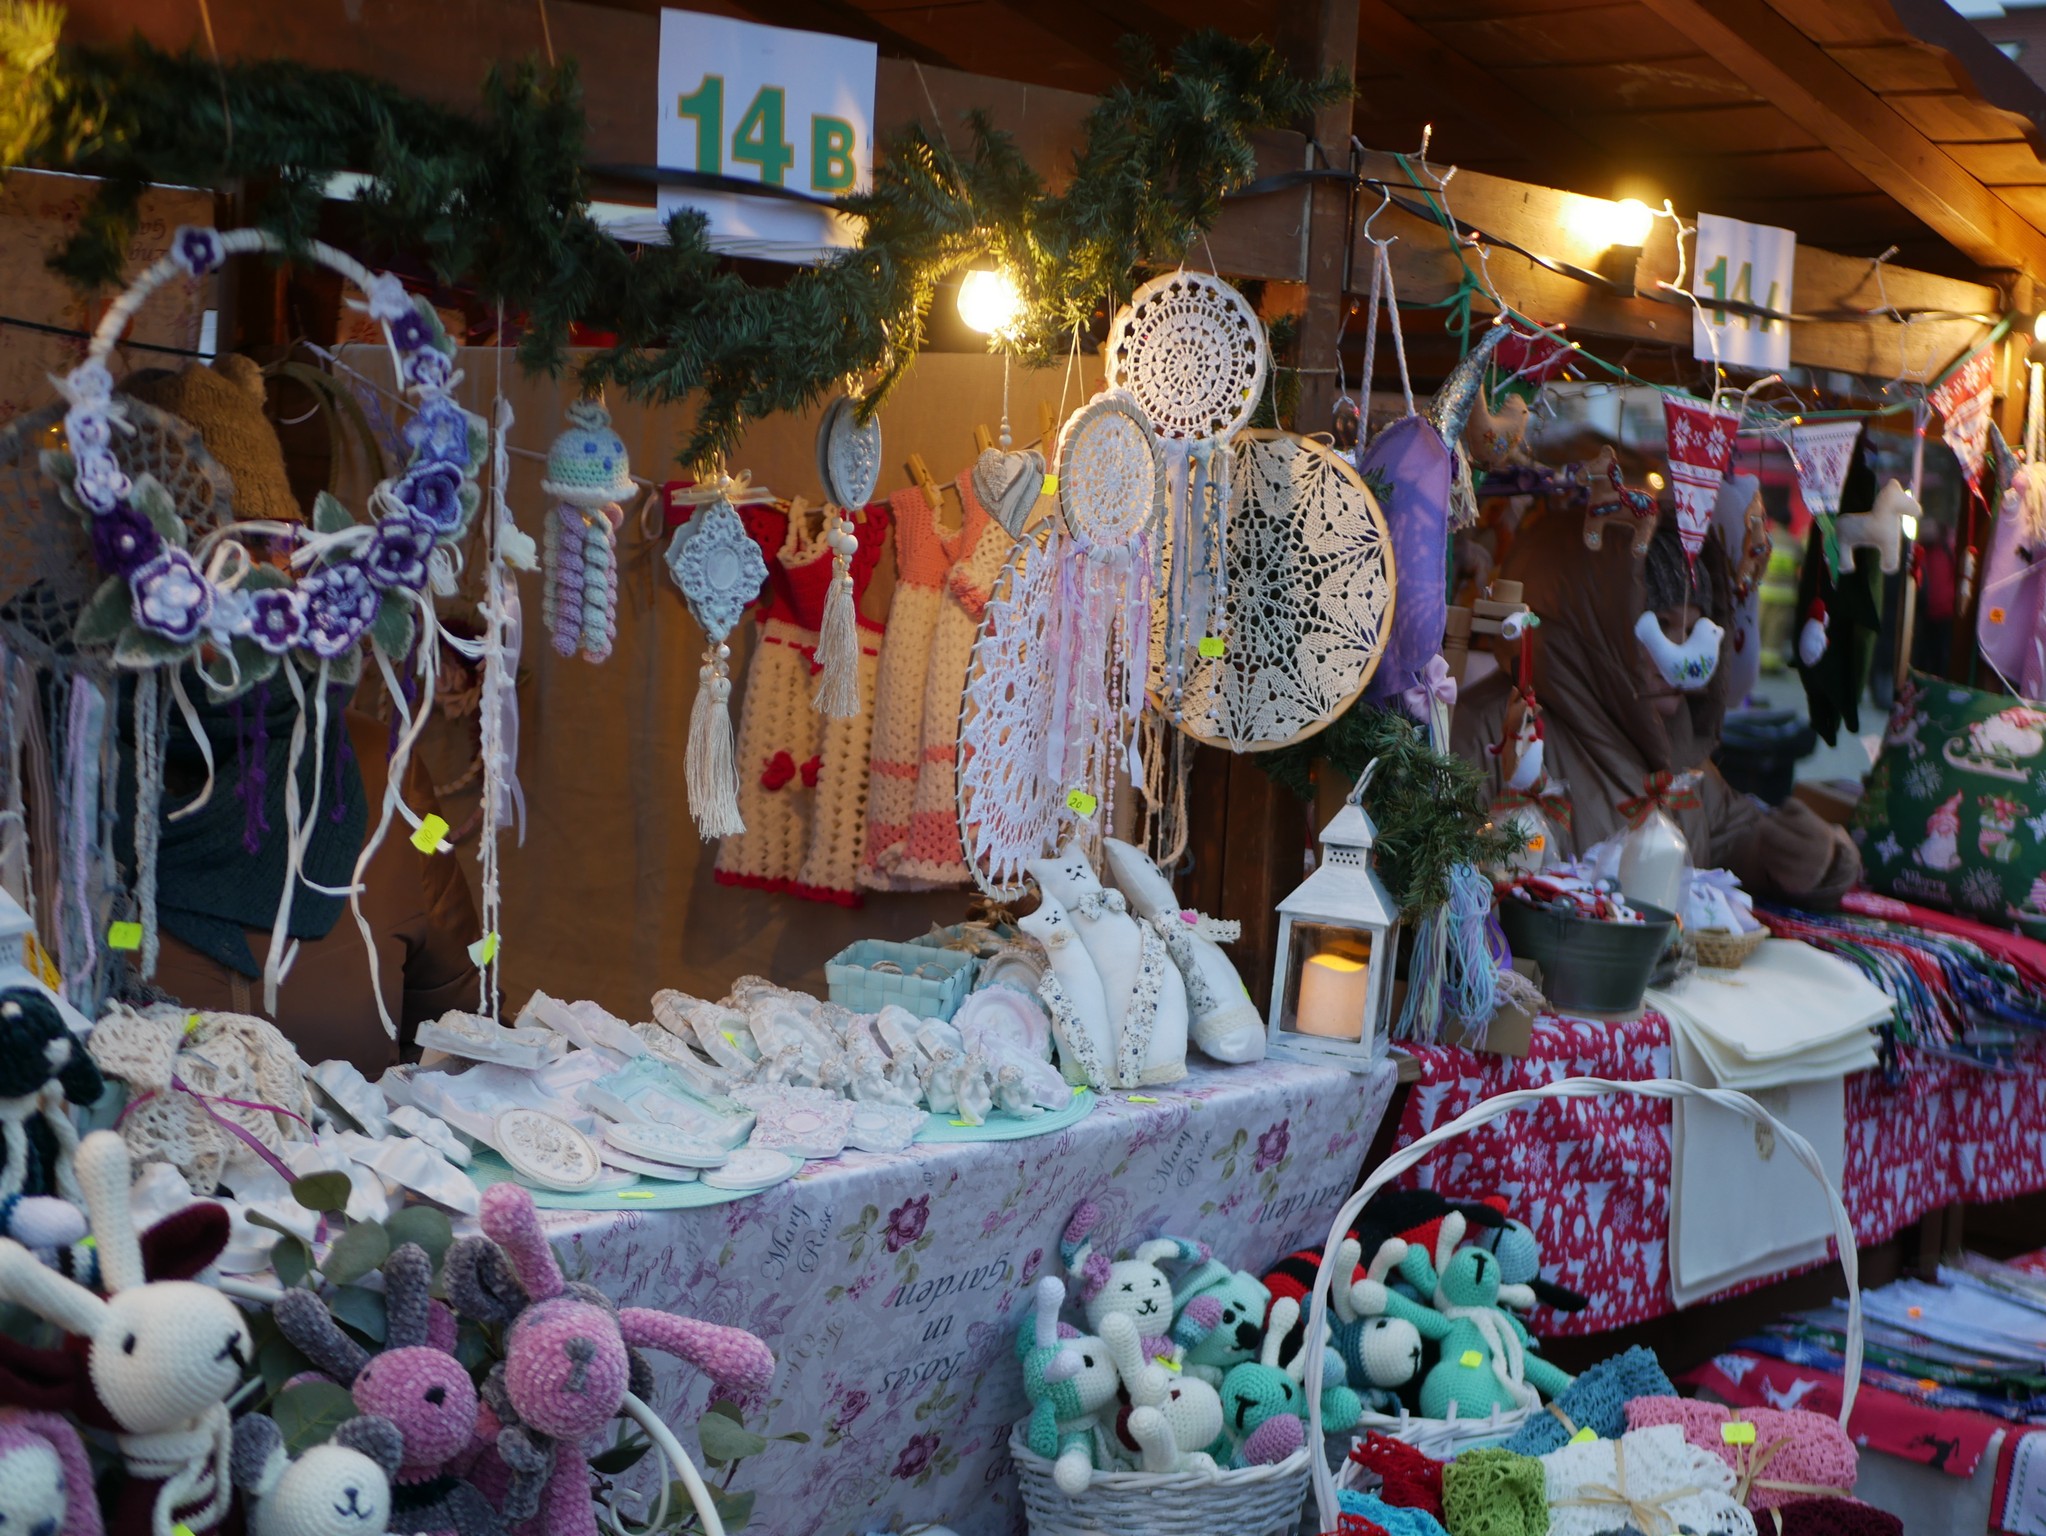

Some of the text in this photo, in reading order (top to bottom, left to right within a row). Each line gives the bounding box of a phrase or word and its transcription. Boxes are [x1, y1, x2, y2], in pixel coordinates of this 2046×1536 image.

[1069, 797, 1082, 808] 20
[1146, 1129, 1193, 1194] Mary
[1177, 1129, 1212, 1188] Rose
[760, 1202, 812, 1281] Mary
[797, 1206, 834, 1273] Rose
[894, 1252, 1010, 1314] Garden
[922, 1314, 954, 1345] in
[877, 1351, 967, 1394] Roses
